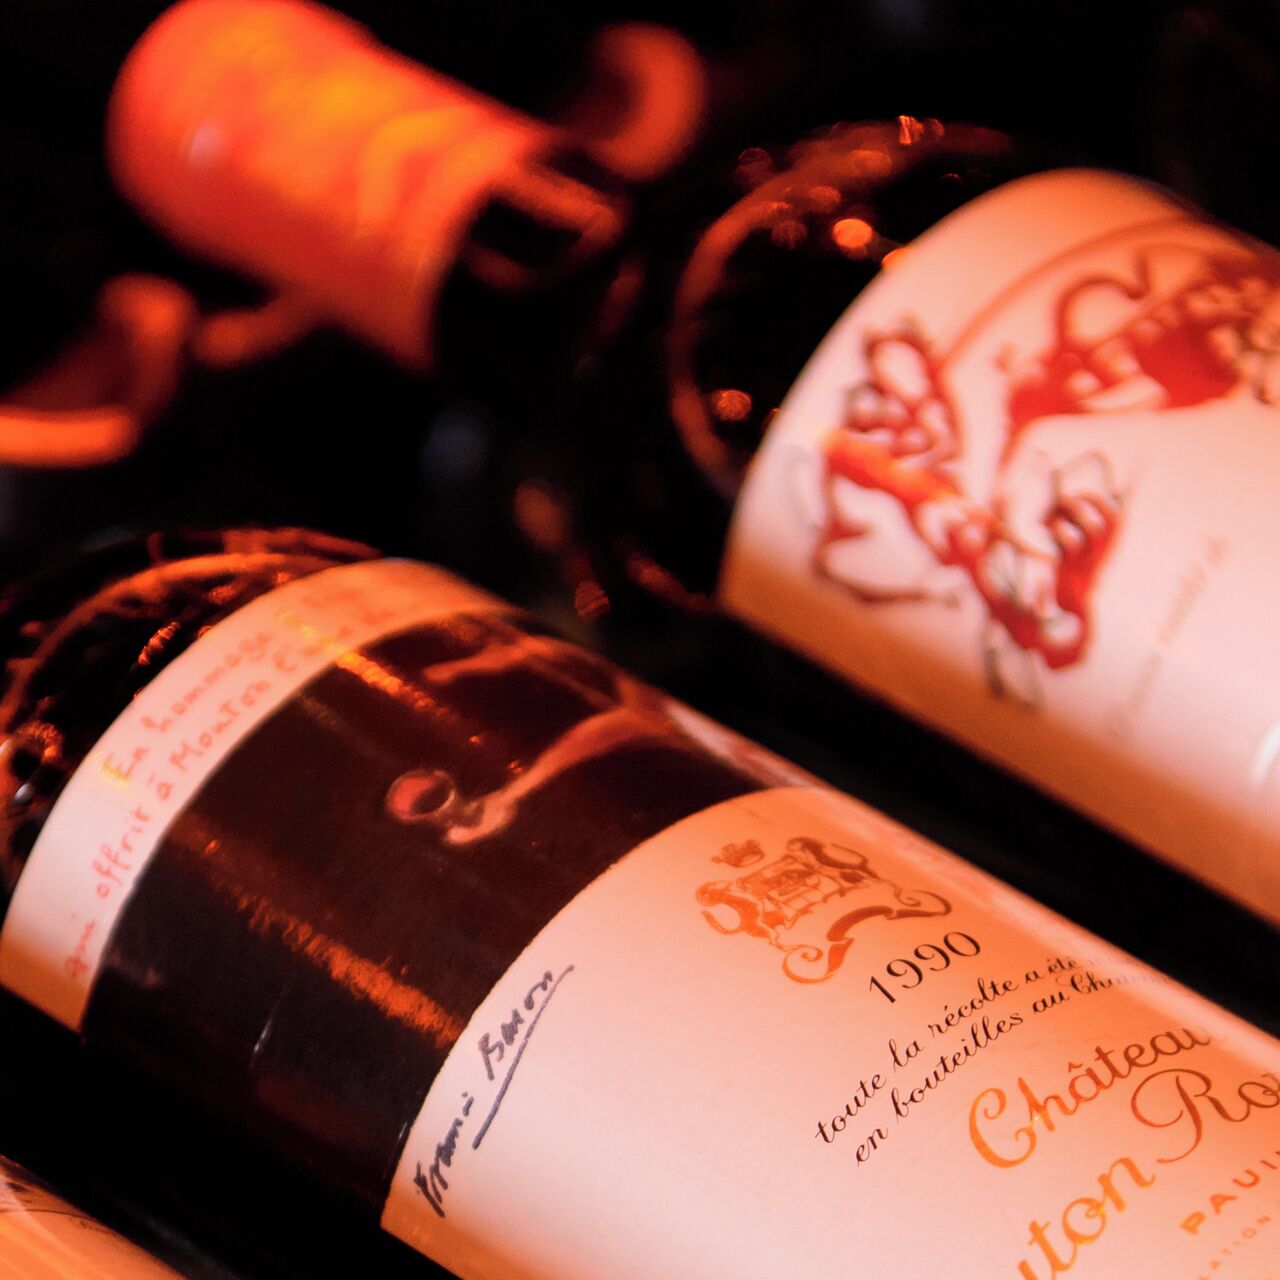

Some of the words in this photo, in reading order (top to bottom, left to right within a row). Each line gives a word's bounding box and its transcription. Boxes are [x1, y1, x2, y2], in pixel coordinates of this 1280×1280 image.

[868, 931, 982, 1004] 1990
[814, 1072, 887, 1144] toute
[888, 1038, 923, 1070] la
[927, 974, 1019, 1038] récolte
[1024, 970, 1044, 987] a
[1047, 956, 1082, 979] été
[854, 1125, 889, 1167] en
[891, 1011, 1024, 1124] bouteilles
[1032, 990, 1071, 1014] au
[967, 1027, 1211, 1169] Château
